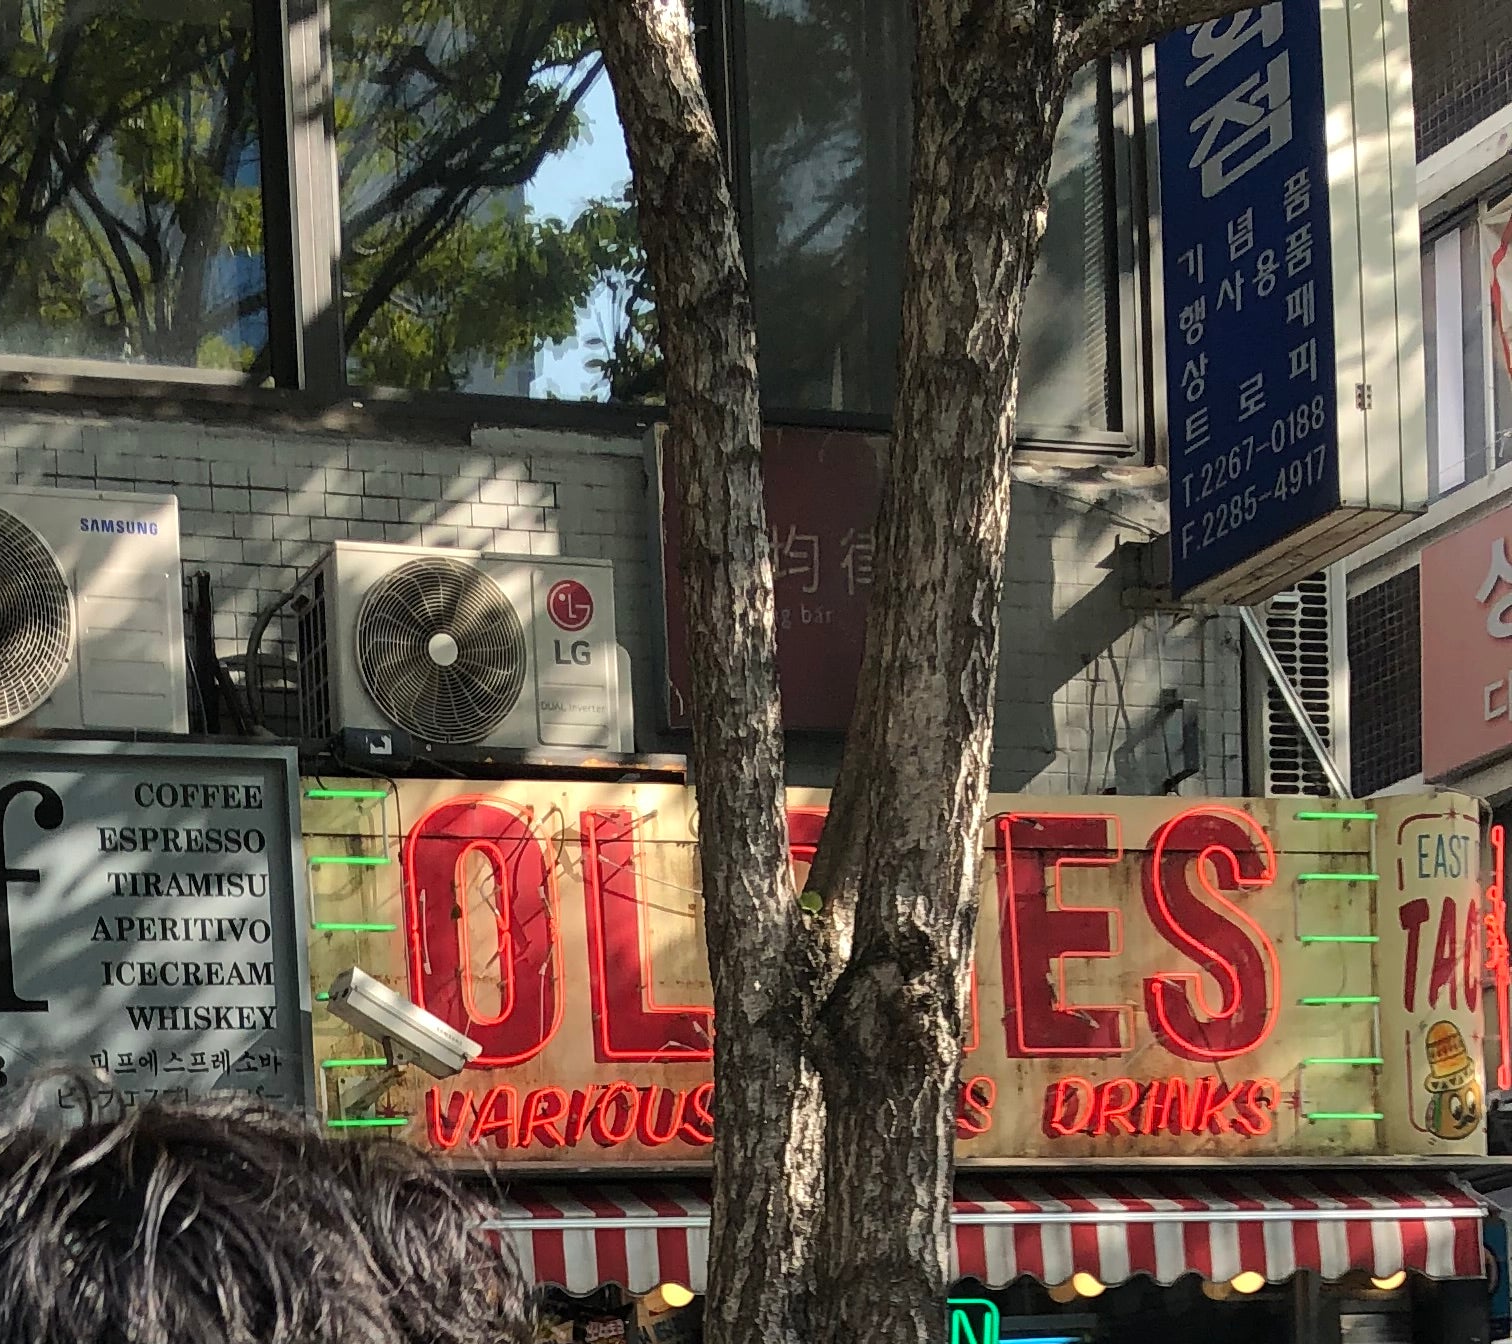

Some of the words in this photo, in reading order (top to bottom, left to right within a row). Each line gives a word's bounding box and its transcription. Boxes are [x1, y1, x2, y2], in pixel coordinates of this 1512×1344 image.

[1181, 394, 1325, 508] T.2267-0188
[1181, 443, 1327, 560] F.2285-4917
[80, 517, 158, 535] SAMSUNG
[554, 639, 591, 666] LG
[134, 782, 263, 809] COFFEE
[96, 826, 266, 853] ESPRESSO
[1418, 834, 1470, 879] EAST
[107, 872, 268, 898] TIRAMISU
[91, 916, 271, 944] APERITIVO
[402, 793, 1281, 1067] OLES
[101, 961, 274, 986] ICECREAM
[125, 1006, 277, 1031] WHISKEY
[425, 1080, 715, 1150] VARIOUS
[1042, 1074, 1281, 1140] DRINKS
